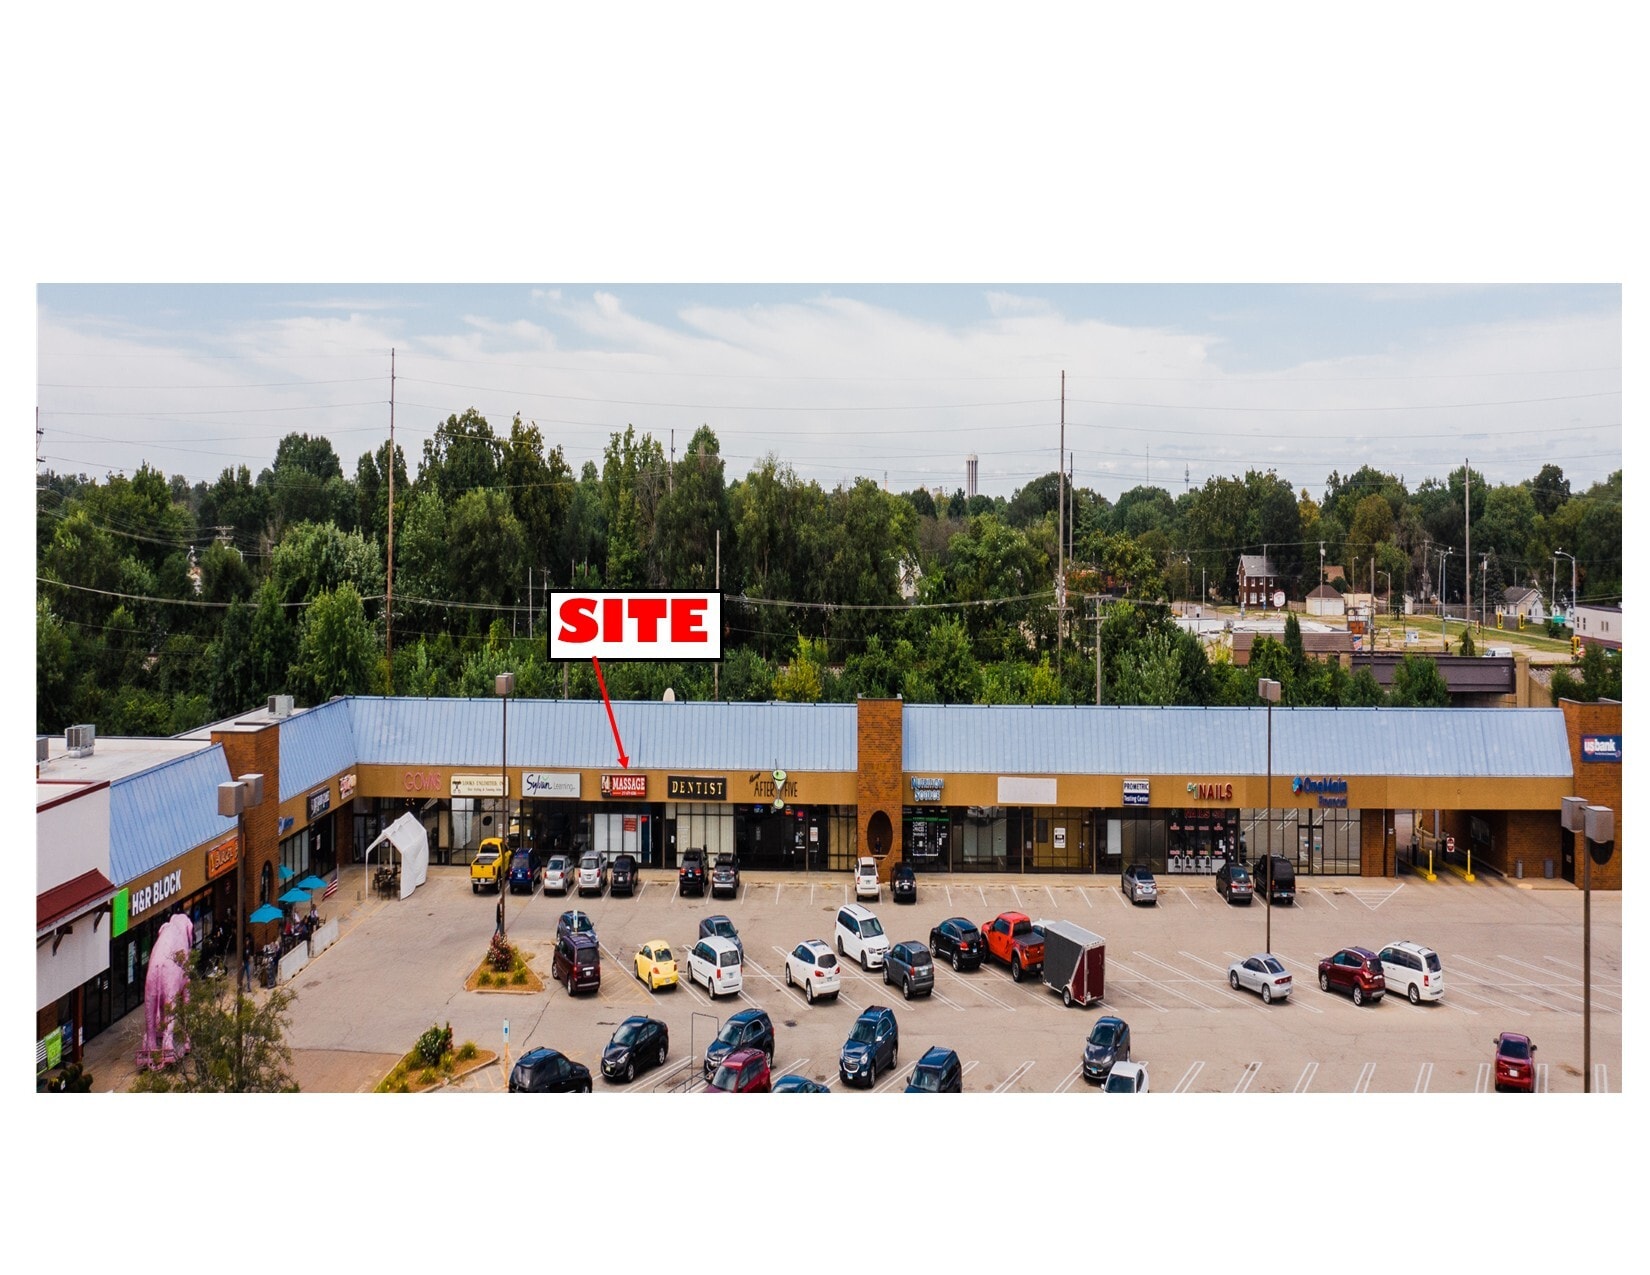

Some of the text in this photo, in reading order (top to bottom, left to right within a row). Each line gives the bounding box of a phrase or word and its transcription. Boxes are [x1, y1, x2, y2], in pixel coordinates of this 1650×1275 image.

[404, 772, 441, 791] GOWNS
[526, 774, 552, 795] Sylvan
[612, 777, 645, 790] MASSAGE
[672, 781, 722, 795] DENTIST
[754, 781, 797, 797] AFTER FIVE
[1303, 776, 1347, 794] OneMain
[1198, 783, 1232, 800] NAILS
[132, 869, 182, 917] H&R BLOCK
